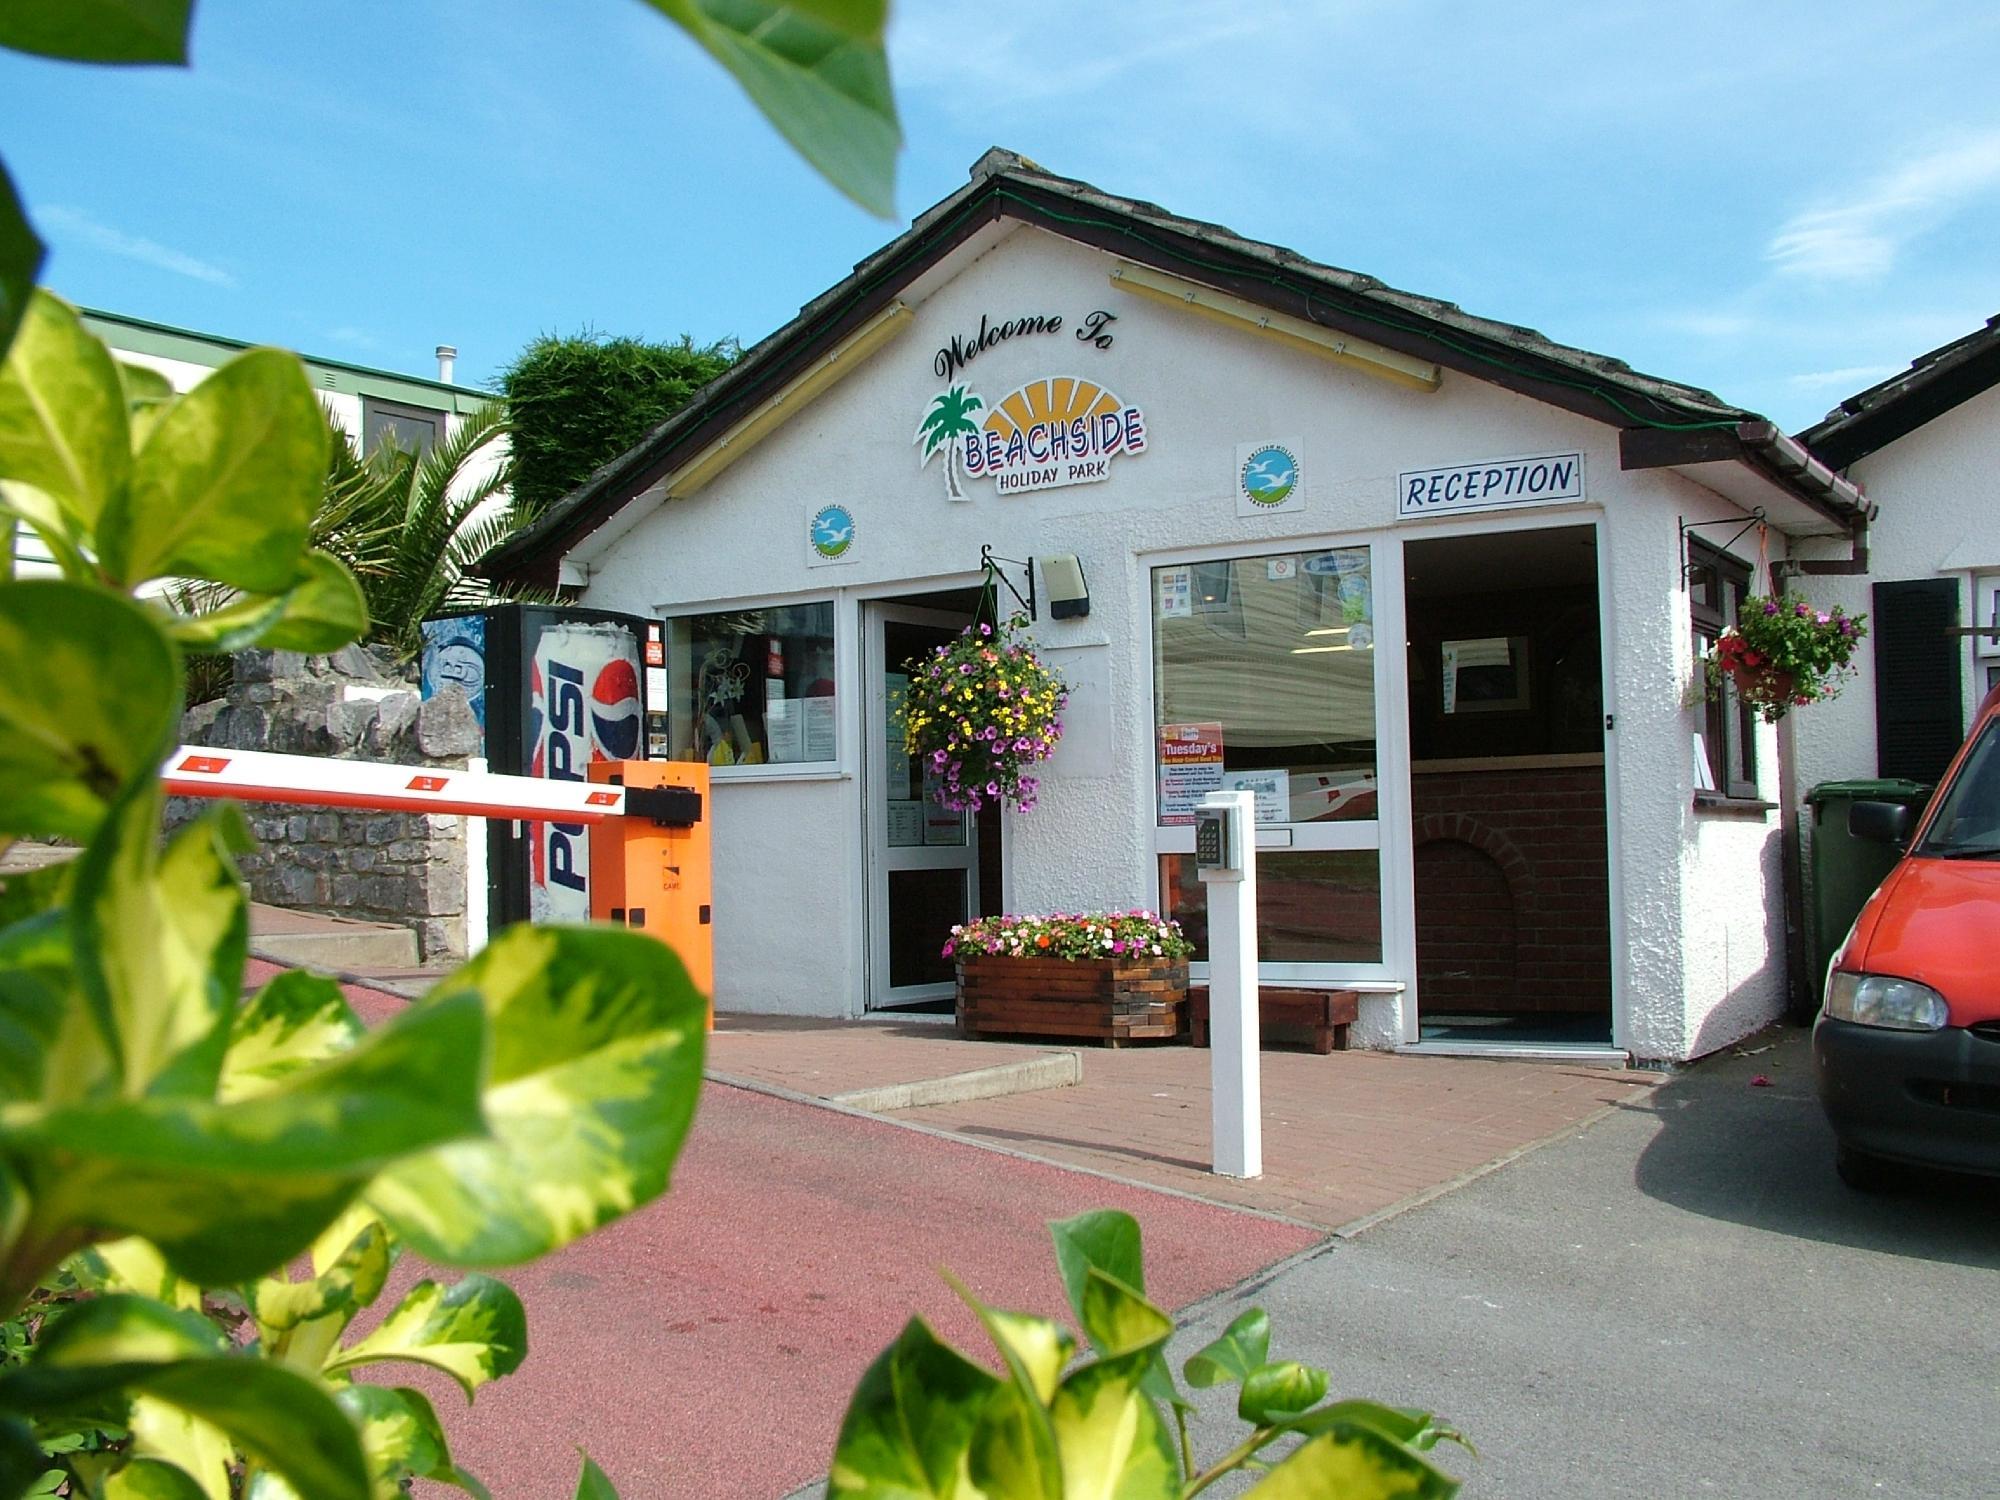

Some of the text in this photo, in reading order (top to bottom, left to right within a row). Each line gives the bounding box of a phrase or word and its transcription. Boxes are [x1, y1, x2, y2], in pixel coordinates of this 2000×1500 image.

[934, 310, 1117, 383] Welcome To
[966, 409, 1143, 473] BEACHSIDE
[1000, 461, 1106, 489] HOLIDAY PARK
[1407, 461, 1574, 506] RECEPTION
[549, 660, 586, 892] PPSI
[1166, 742, 1217, 756] Tuesday's
